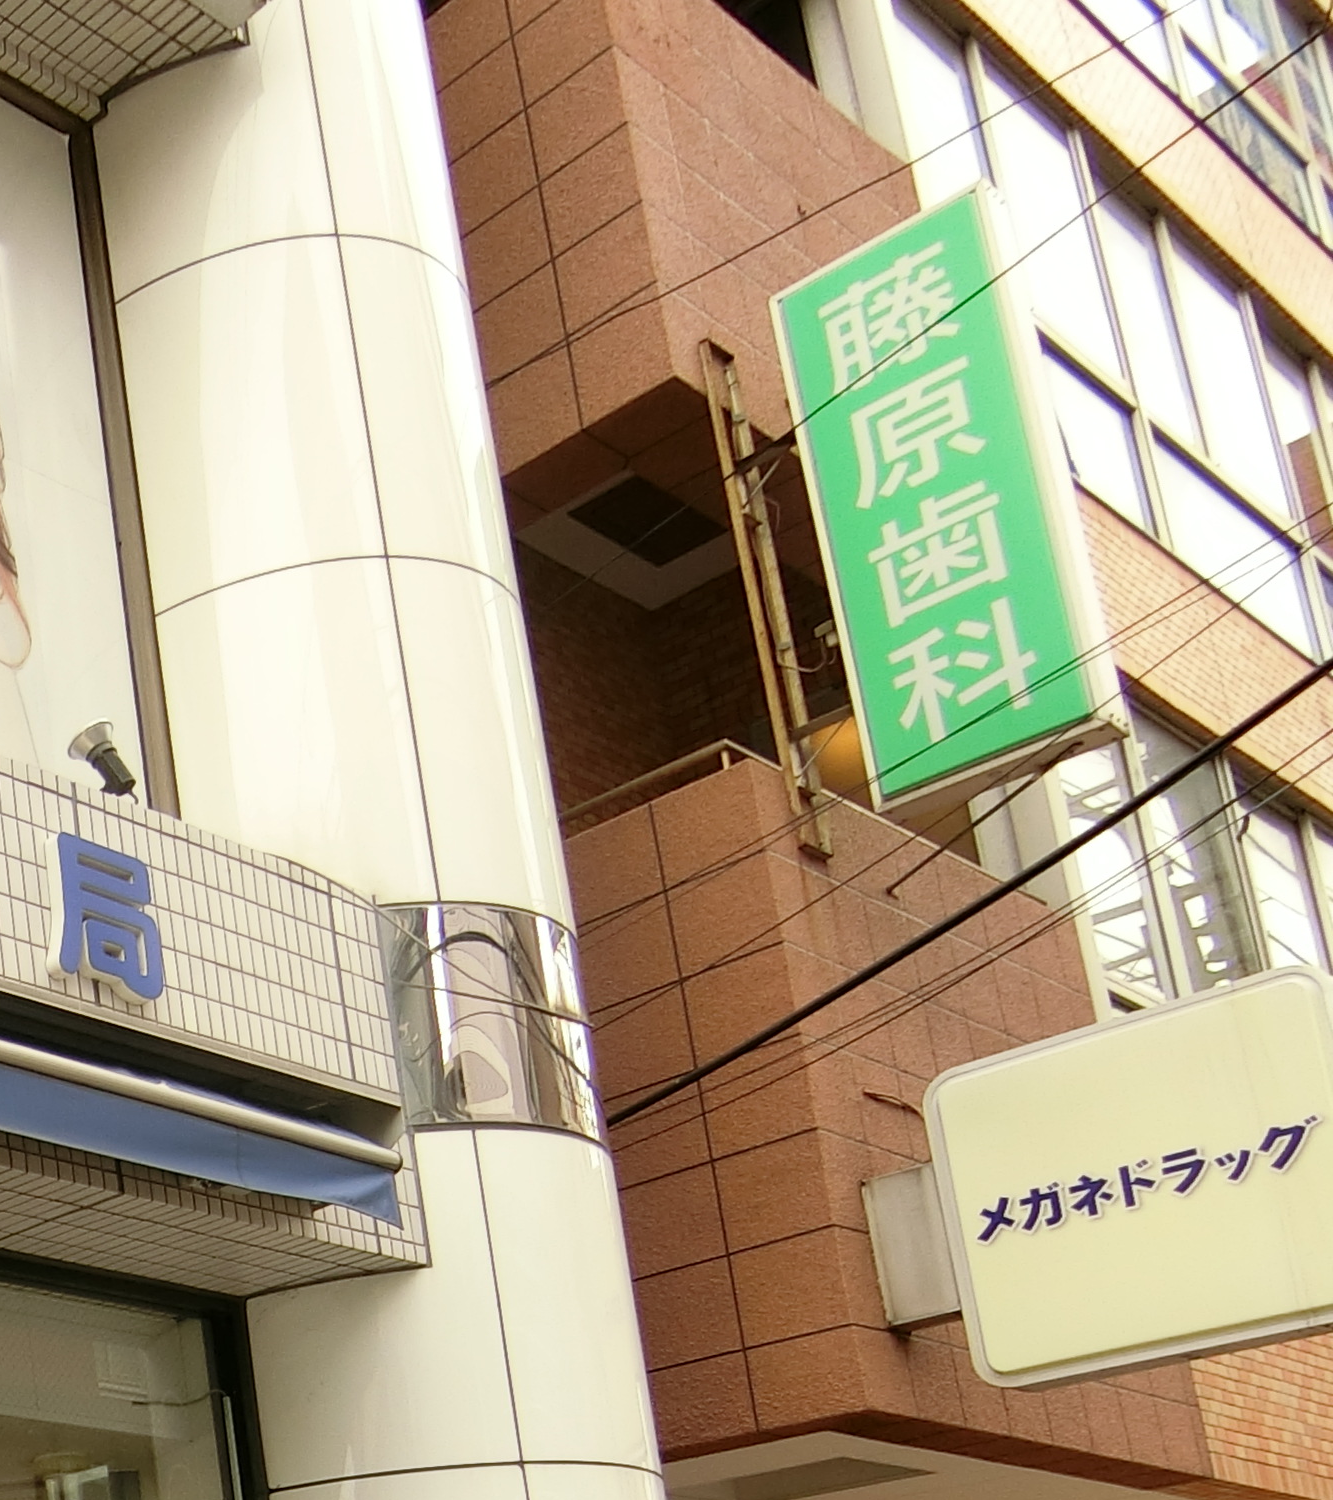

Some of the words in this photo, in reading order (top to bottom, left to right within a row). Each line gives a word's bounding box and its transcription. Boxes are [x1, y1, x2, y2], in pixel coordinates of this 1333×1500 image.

[818, 238, 1040, 744] 藤原歯科
[975, 1114, 1323, 1243] メガネドラッグ
